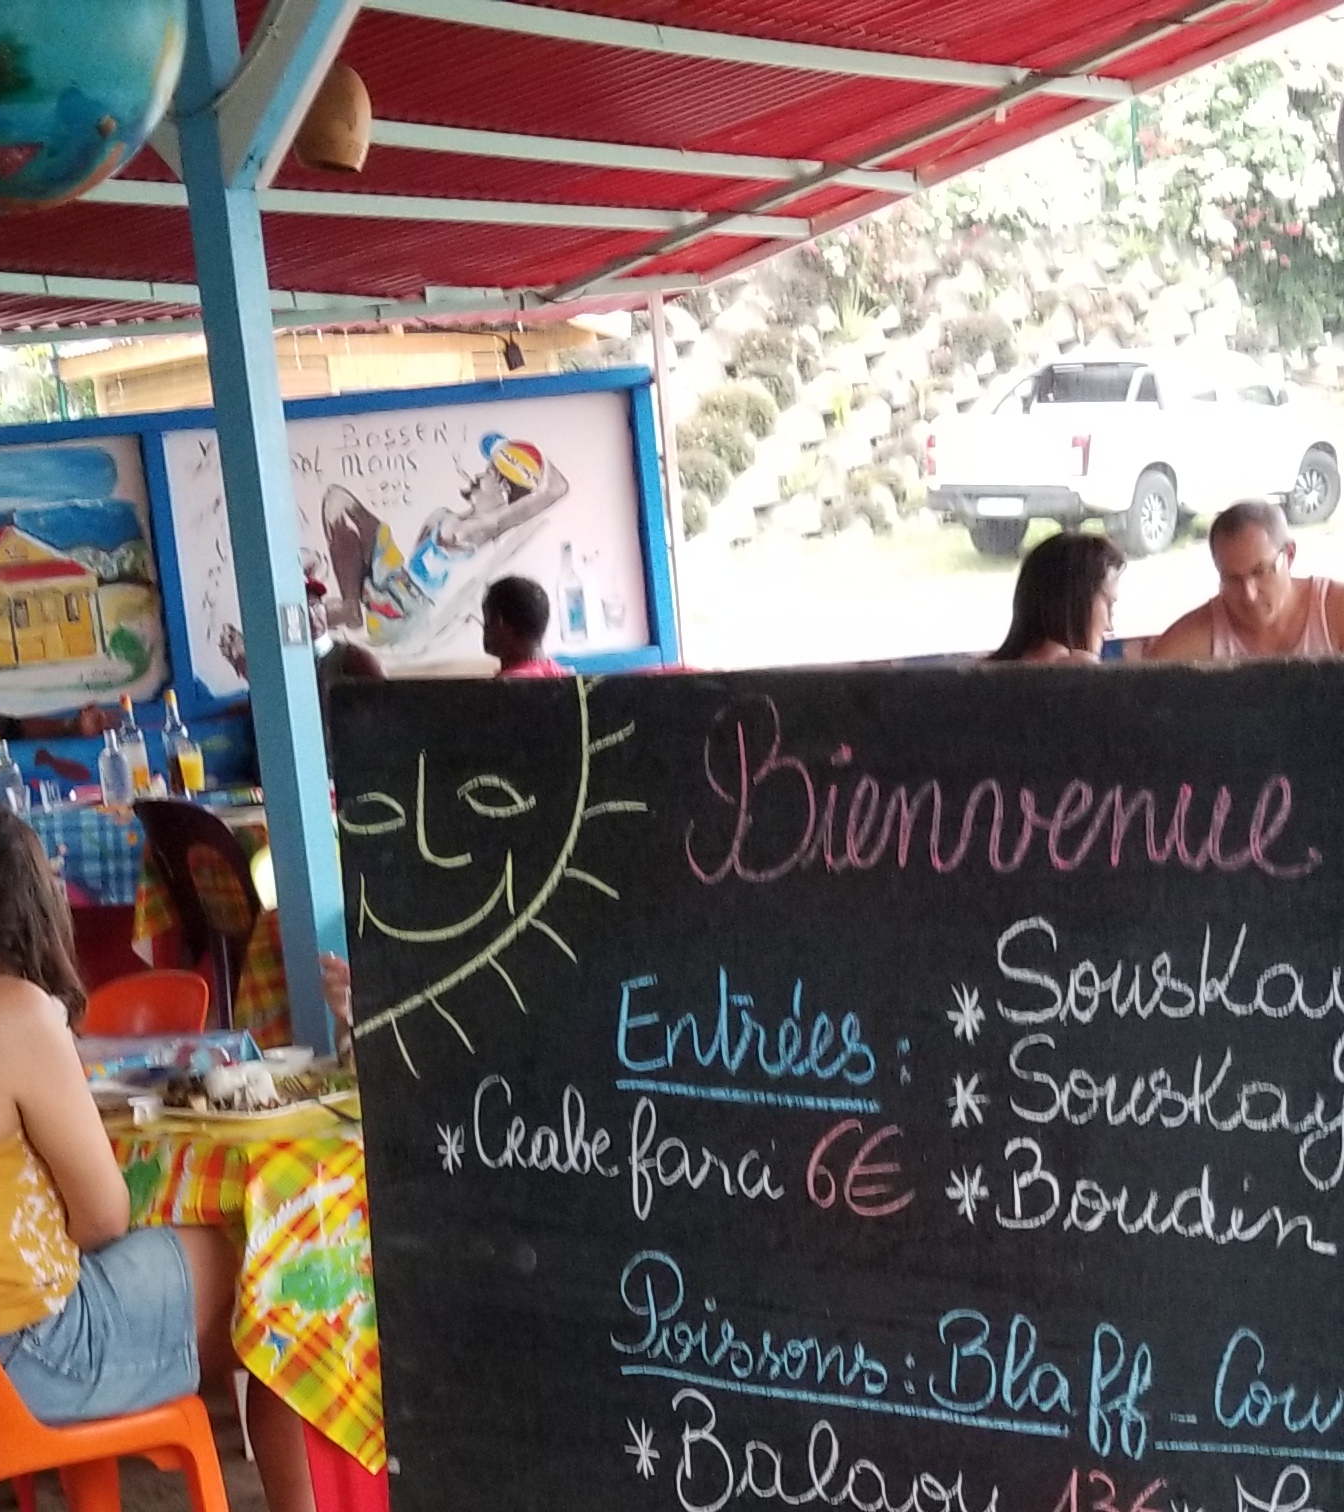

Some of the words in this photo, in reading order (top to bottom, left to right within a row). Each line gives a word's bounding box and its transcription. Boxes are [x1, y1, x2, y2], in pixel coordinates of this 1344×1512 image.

[685, 693, 1323, 886] Bienvenue
[806, 1118, 917, 1218] 6€
[995, 1136, 1337, 1259] Boudin
